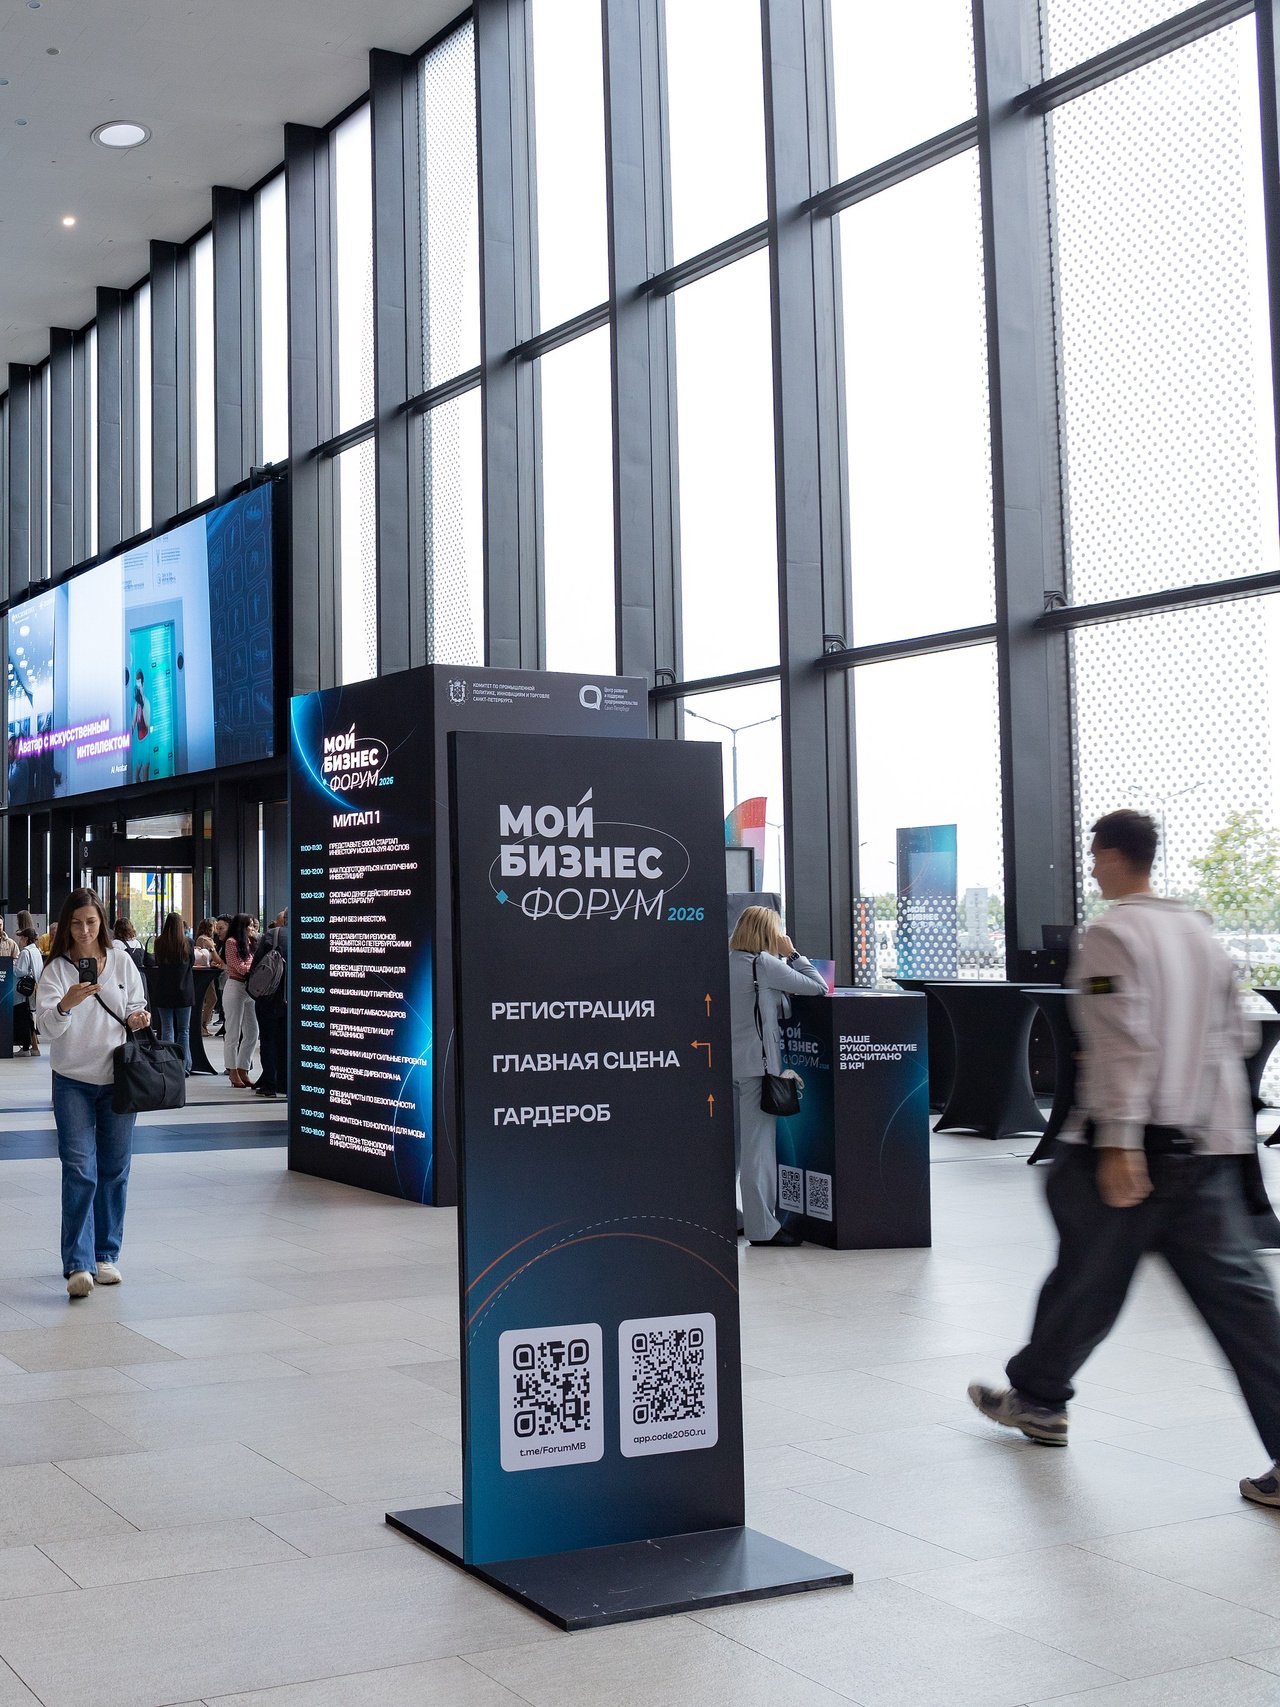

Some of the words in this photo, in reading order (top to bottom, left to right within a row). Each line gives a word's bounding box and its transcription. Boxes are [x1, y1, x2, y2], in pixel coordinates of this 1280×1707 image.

[18, 736, 42, 755] Аватар
[44, 737, 48, 748] с
[50, 718, 109, 747] искусственным
[324, 722, 356, 754] МОЙ
[77, 734, 130, 759] интеллектом
[324, 748, 379, 773] БИЗНЕС
[330, 770, 380, 792] ФОРУМ
[379, 776, 394, 787] 2026
[332, 811, 372, 828] МИТАП
[375, 810, 380, 824] 1
[499, 786, 594, 838] МОЙ
[83, 846, 88, 858] 8
[329, 840, 361, 849] ПРЕДСТАВЬТЕ
[357, 845, 386, 853] ИСПОЛЬЗУЯ
[340, 864, 379, 873] ПОДГОТОВИТЬСЯ
[384, 862, 417, 870] ПОЛУЧЕНИЮ
[500, 845, 663, 879] БИЗНЕС
[367, 888, 411, 897] ДЕЙСТВИТЕЛЬНО
[521, 887, 664, 921] ФОРУМ
[667, 907, 705, 921] 2026
[330, 945, 385, 954] ПРЕДПРИНИМАТЕЛЯМИ
[364, 965, 393, 973] ПЛОЩАДКИ
[330, 988, 360, 996] ФРАНШИЗЫ
[330, 1006, 349, 1014] БРЕНДЫ
[349, 1007, 363, 1016] ИЩУТ
[364, 1009, 406, 1019] АМБАССАДОРОВ
[491, 1000, 655, 1020] РЕГИСТРАЦИЯ
[330, 1023, 378, 1034] ПРЕДПРИНИМАТЕЛИ
[379, 1027, 394, 1036] ИЩУТ
[330, 1030, 364, 1039] НАСТАВНИКОВ
[330, 1047, 361, 1057] НАСТАВНИКИ
[362, 1051, 376, 1060] ИЩУТ
[377, 1053, 401, 1062] СИЛЬНЫЕ
[402, 1056, 427, 1065] ПРОЕКТЫ
[839, 1044, 917, 1052] РУКОПОЖАТИЕ
[492, 1052, 599, 1072] ГЛАВНАЯ
[603, 1050, 680, 1071] СЦЕНА
[840, 1062, 847, 1070] В
[848, 1062, 864, 1070] KPI
[330, 1064, 363, 1075] ФИНАНСОВЫЕ
[364, 1069, 392, 1080] ДИРЕКТОРА
[330, 1089, 365, 1102] СПЕЦИАЛИСТЫ
[374, 1096, 415, 1109] БЕЗОПАСНОСТИ
[330, 1096, 352, 1105] БИЗНЕСА
[493, 1104, 611, 1127] ГАРДЕРОБ
[363, 1119, 395, 1132] ТЕХНОЛОГИИ
[396, 1126, 407, 1136] ДЛЯ
[408, 1129, 425, 1139] МОДЫ
[361, 1138, 394, 1151] ТЕХНОЛОГИИ
[363, 1145, 386, 1157] КРАСОТЫ
[633, 1428, 706, 1444] app.code2050.ru
[520, 1441, 586, 1457] t.me/ForumMB
